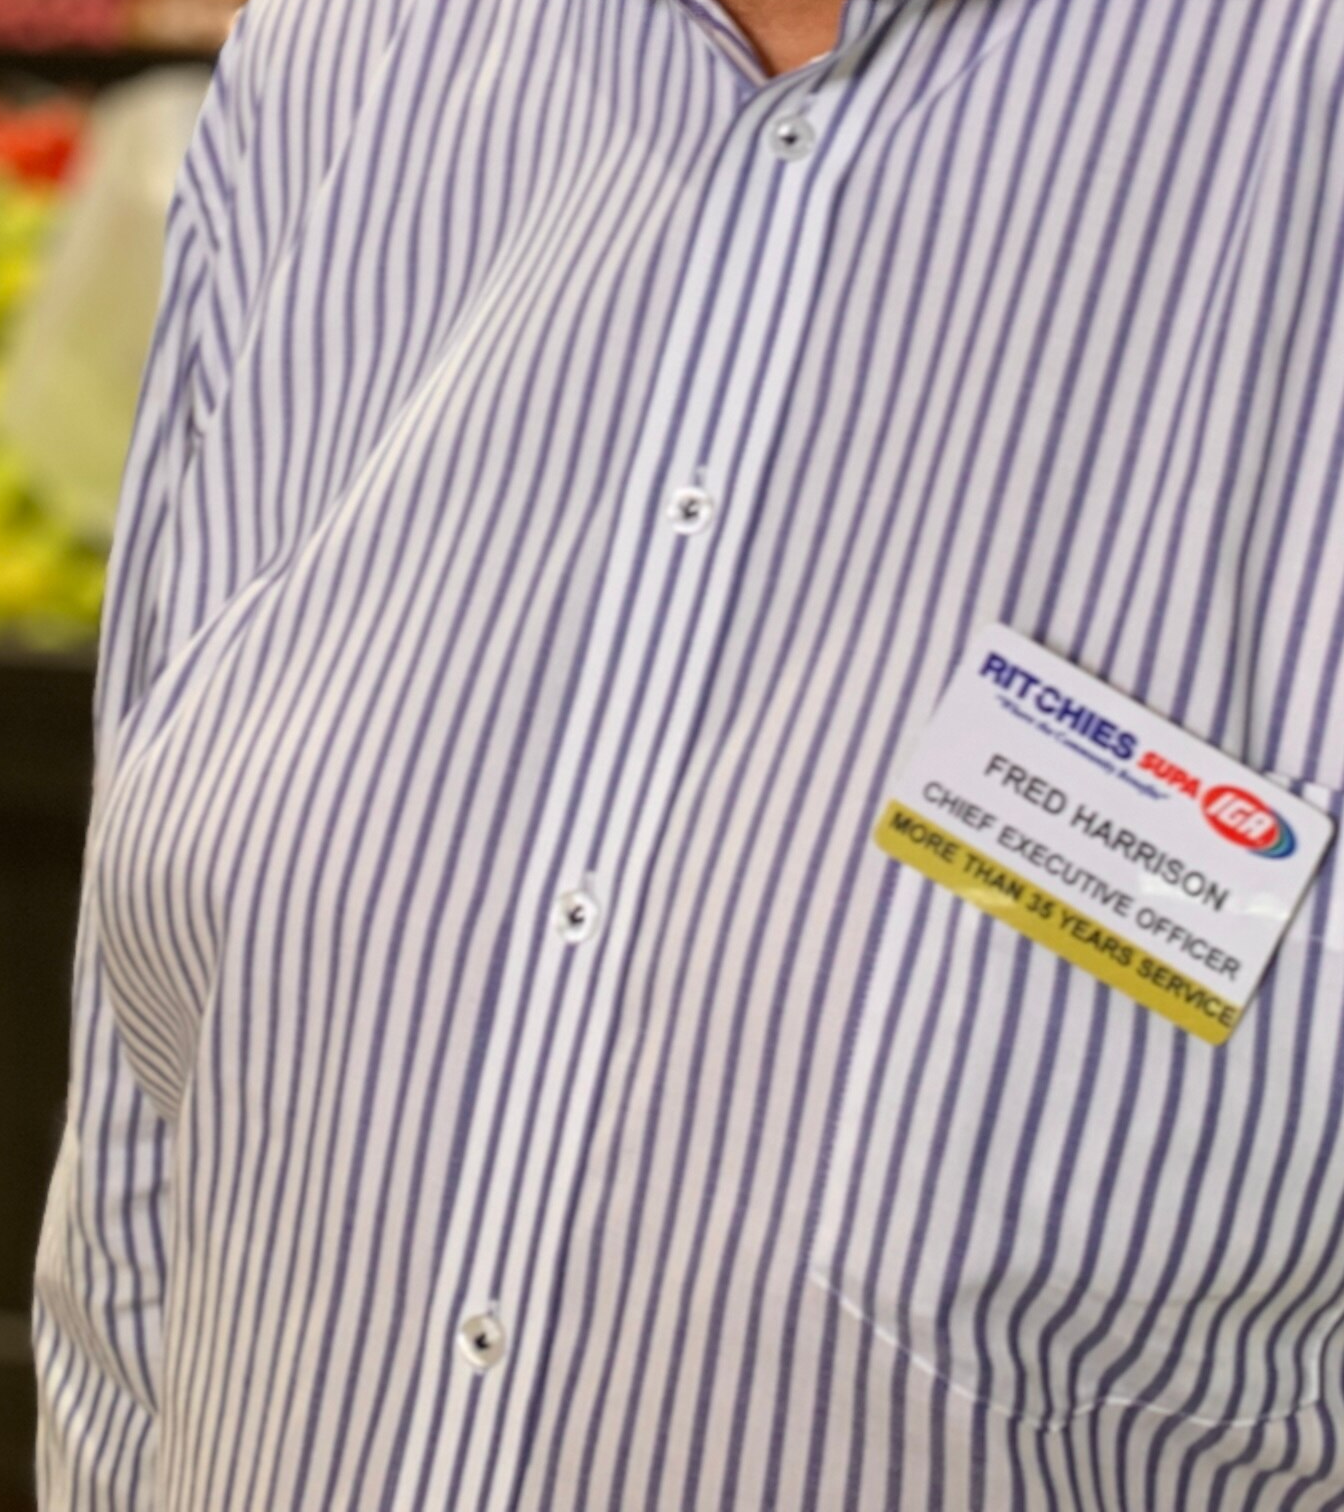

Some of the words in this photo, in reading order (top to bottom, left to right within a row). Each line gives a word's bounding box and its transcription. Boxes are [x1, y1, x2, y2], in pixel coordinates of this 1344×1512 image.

[979, 651, 1138, 761] RITCHIES
[1138, 751, 1200, 800] SUPA
[1205, 791, 1273, 840] IGA
[984, 754, 1067, 815] FRED
[1070, 805, 1229, 912] HARRISON
[892, 812, 956, 860] MORE
[963, 853, 1024, 900] THAN
[1028, 894, 1054, 919] 35
[1062, 915, 1133, 966] YEARS
[1138, 959, 1237, 1028] SERVICE
[923, 781, 996, 830] CHIEF
[997, 825, 1134, 917] EXECUTIVE
[1136, 907, 1241, 980] OFFICER
